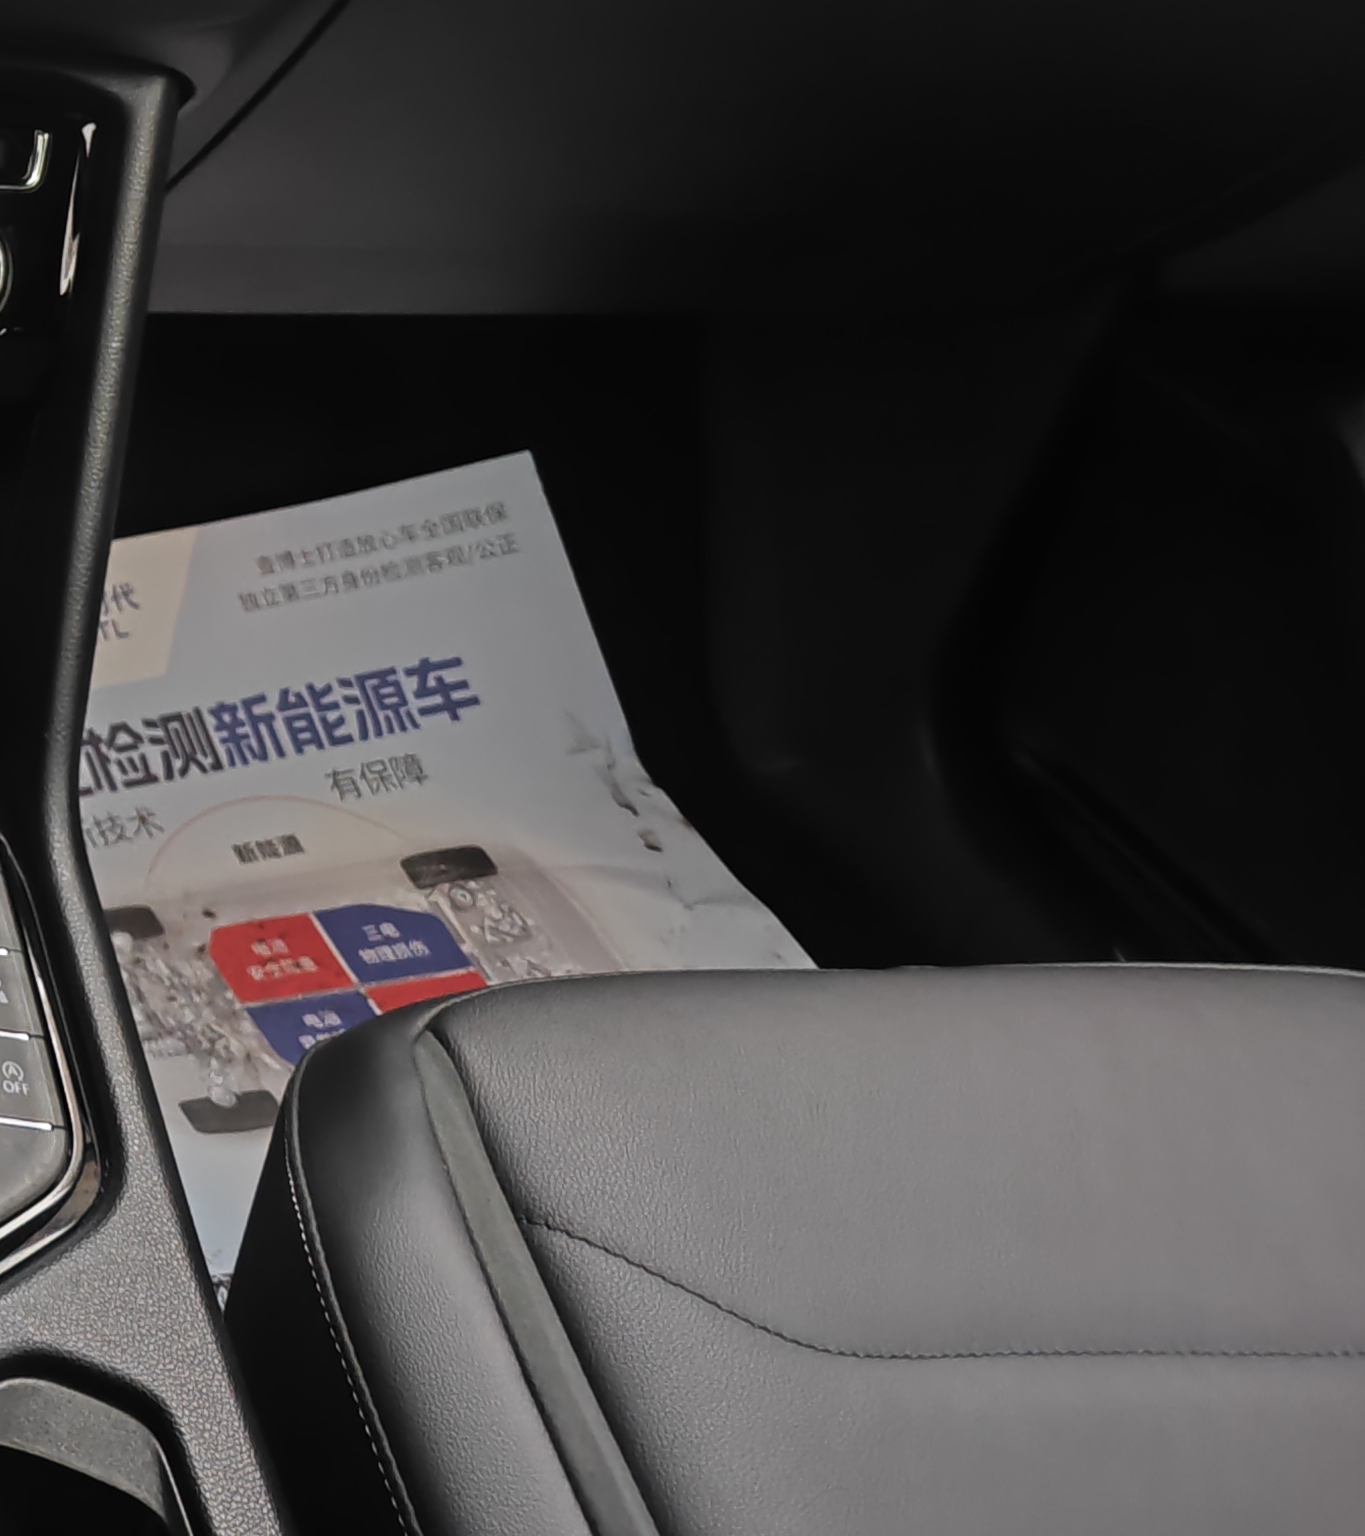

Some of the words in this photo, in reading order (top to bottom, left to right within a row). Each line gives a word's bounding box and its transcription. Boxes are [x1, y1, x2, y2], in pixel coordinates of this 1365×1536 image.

[324, 753, 429, 803] 有保障
[2, 1080, 30, 1097] OFF
